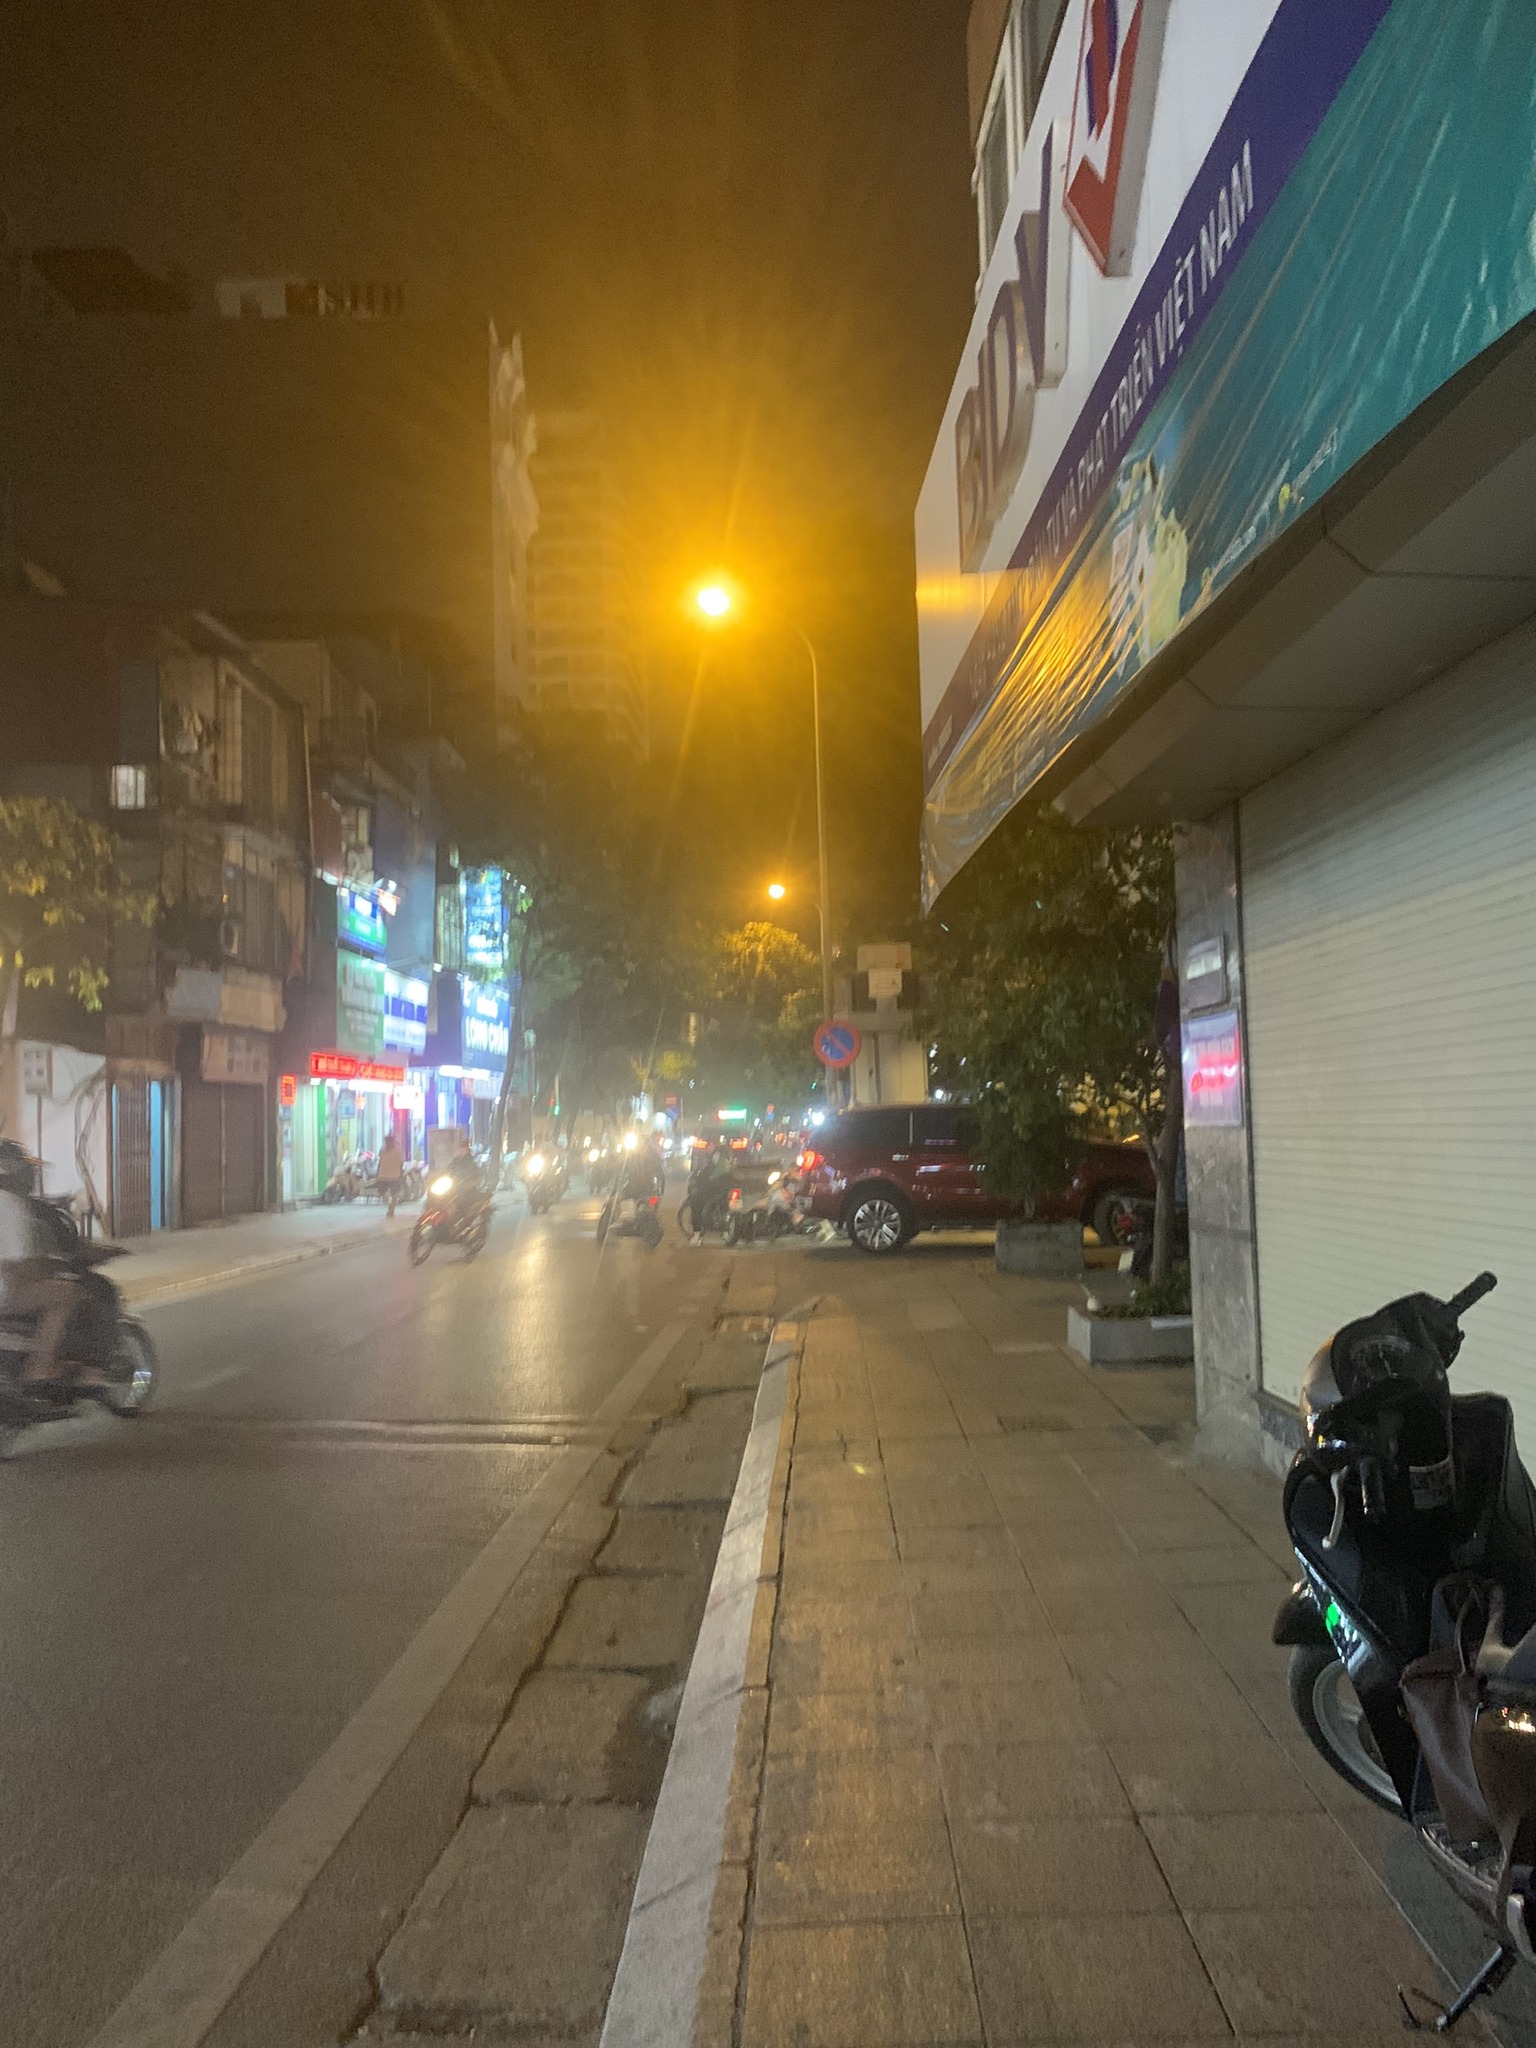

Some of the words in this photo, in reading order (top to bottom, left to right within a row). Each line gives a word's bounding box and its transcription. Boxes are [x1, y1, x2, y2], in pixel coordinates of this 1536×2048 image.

[1109, 322, 1154, 453] TRIỂN
[1154, 244, 1196, 369] VIỆT
[1199, 139, 1254, 296] NAM
